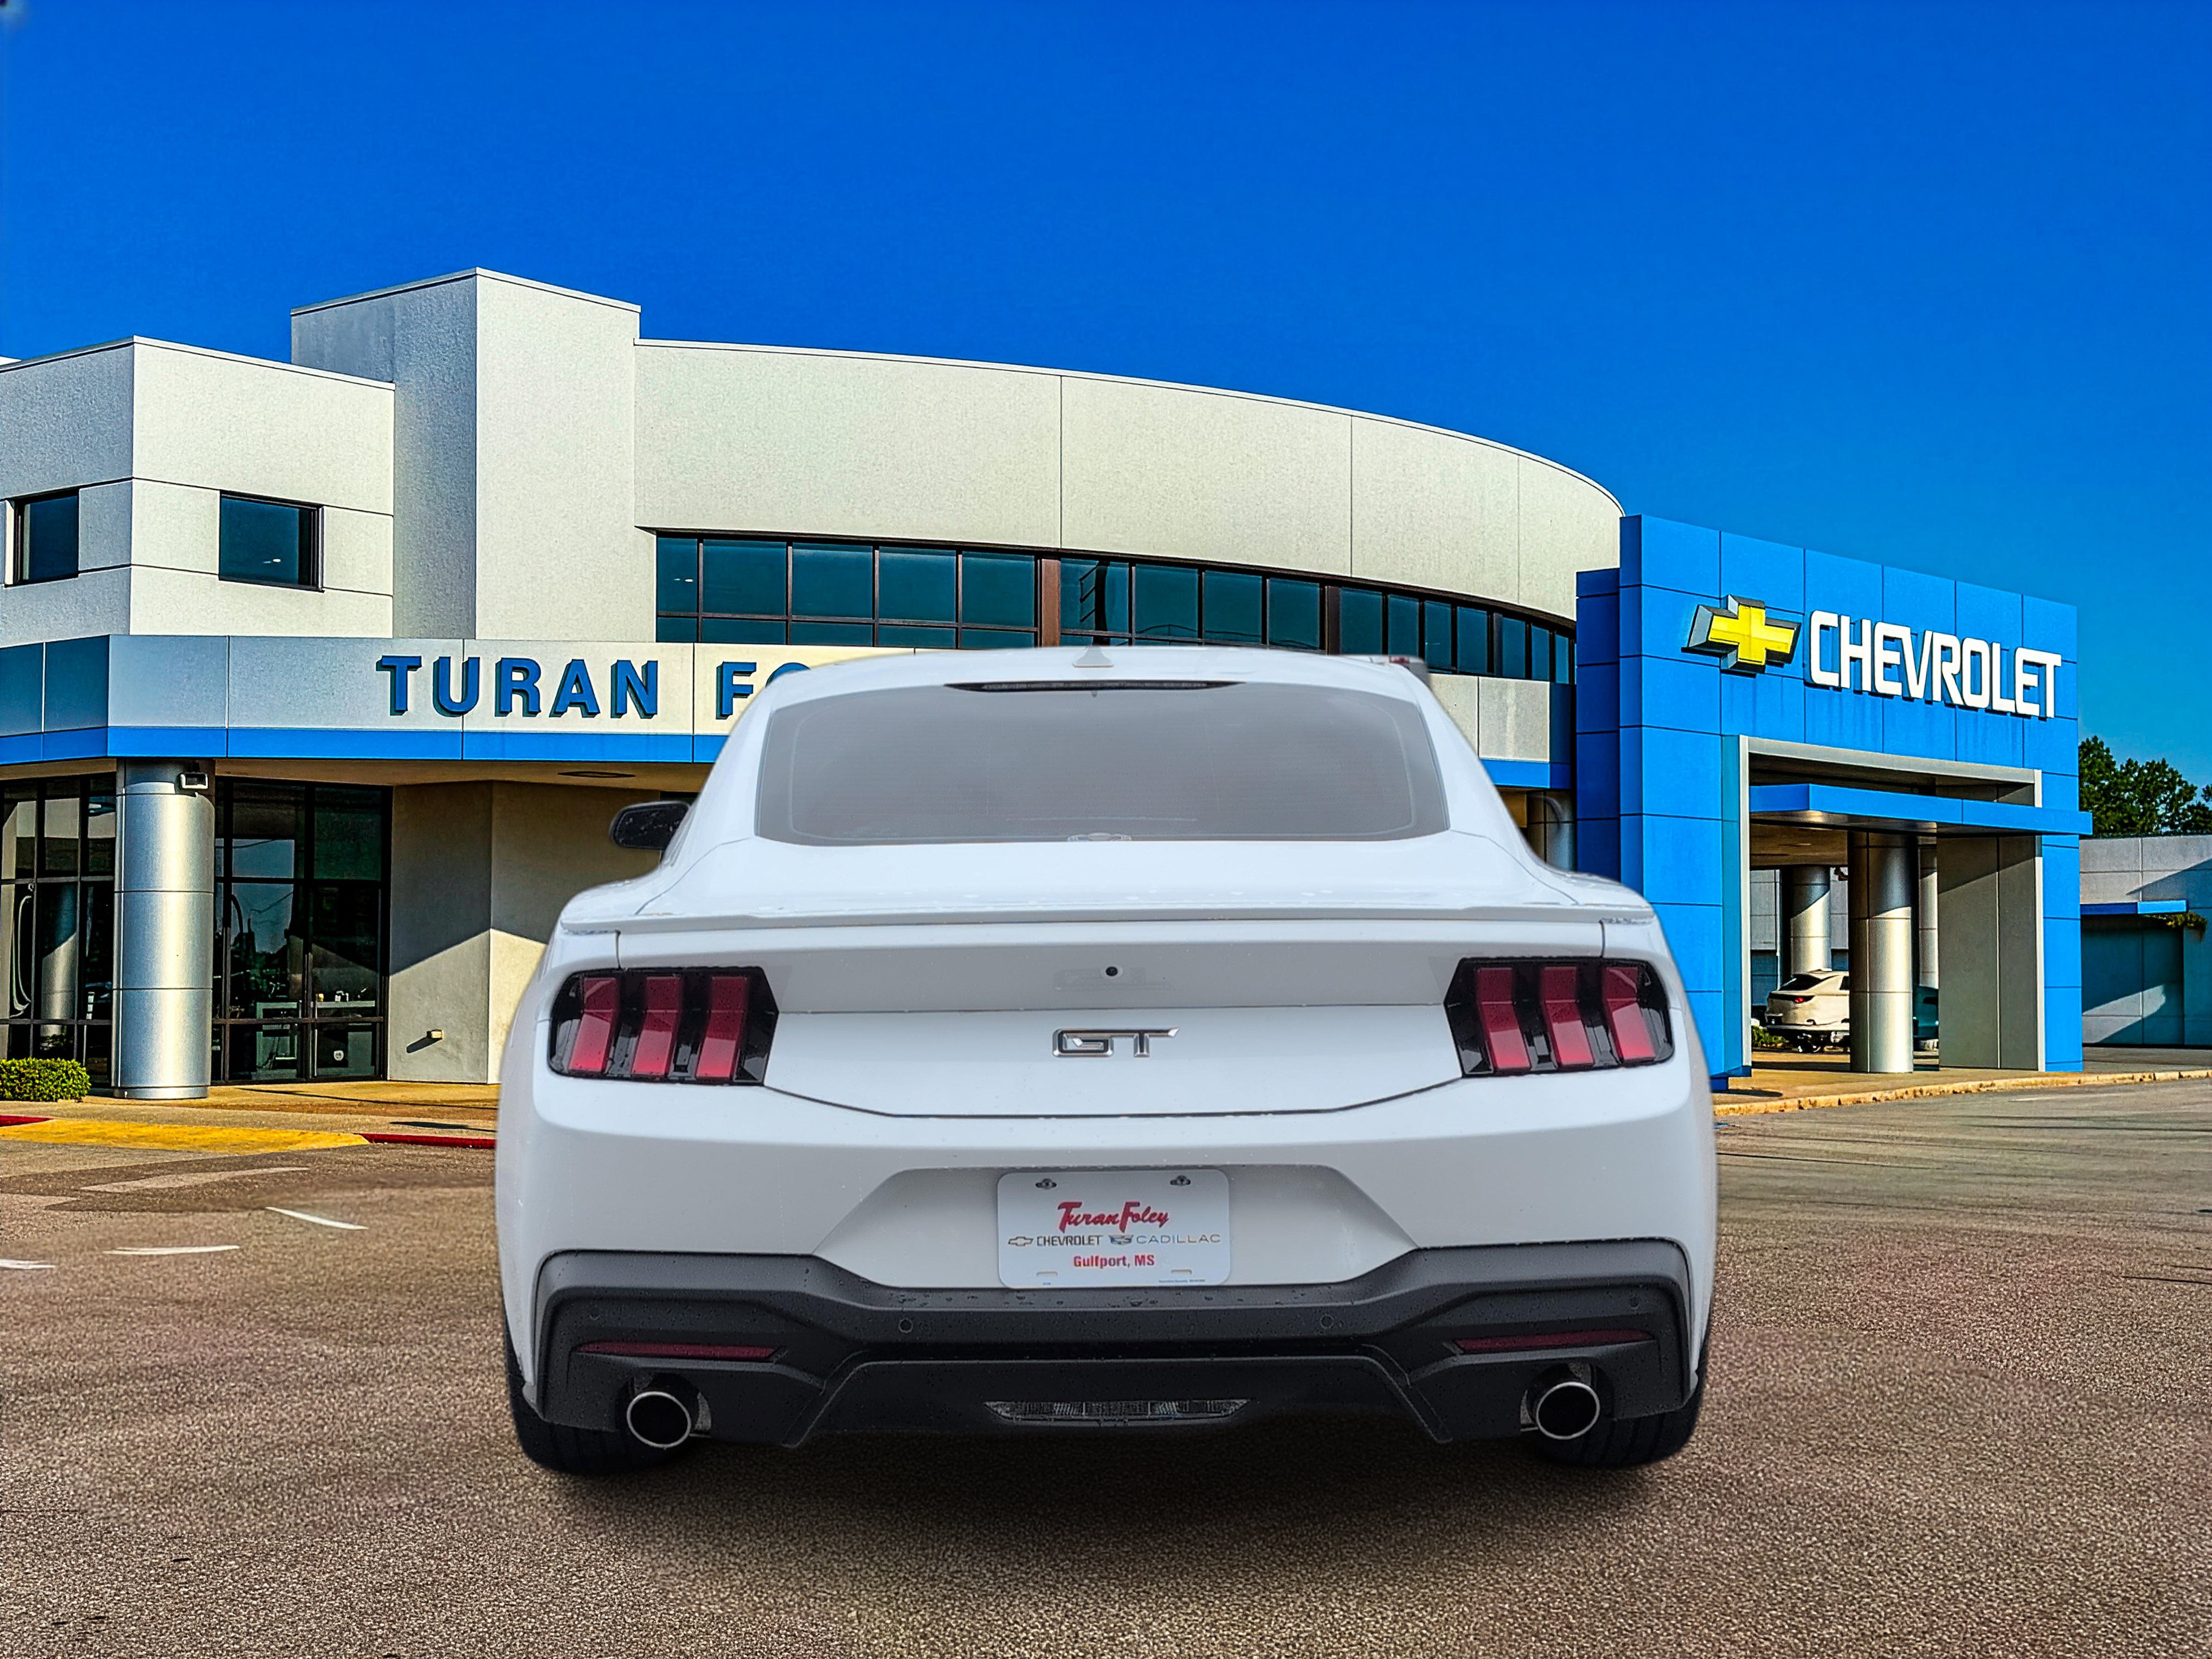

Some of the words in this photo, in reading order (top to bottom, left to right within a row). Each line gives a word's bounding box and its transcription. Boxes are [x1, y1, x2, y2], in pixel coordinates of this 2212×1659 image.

[1810, 610, 2062, 718] CHEVROLET
[376, 655, 659, 719] TURAN
[716, 661, 812, 720] F
[1052, 1027, 1180, 1058] GT
[1037, 1235, 1104, 1246] CHEVROLET
[1136, 1233, 1221, 1244] CADILLAC
[1073, 1255, 1130, 1269] Gulfport,
[1134, 1254, 1155, 1267] MS
